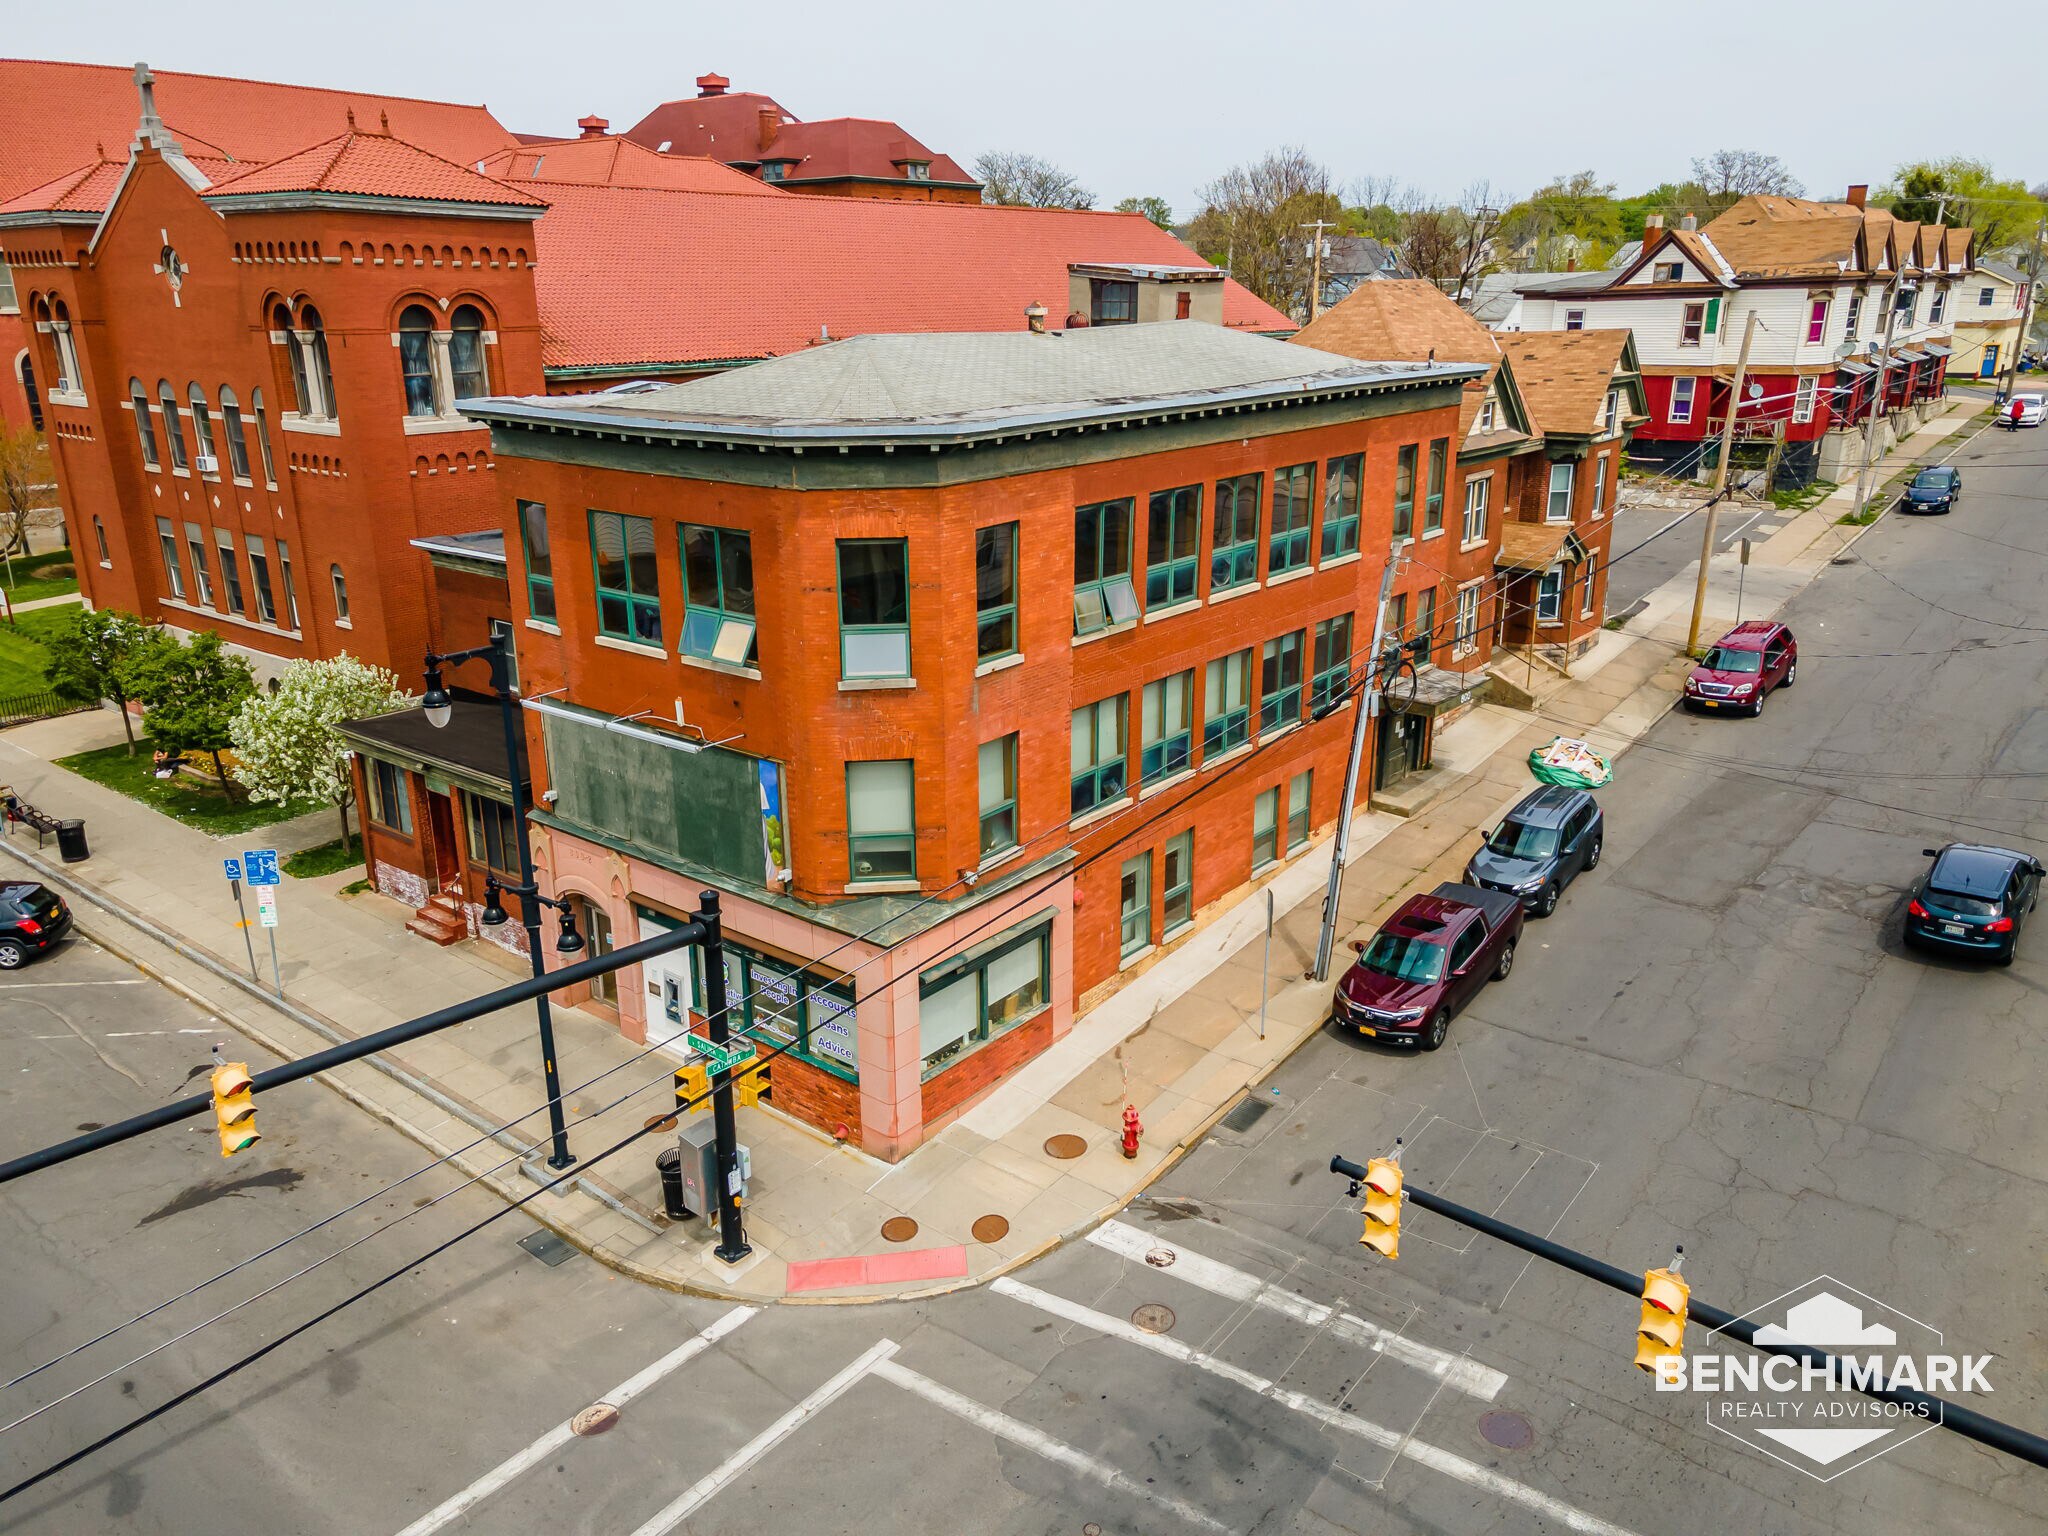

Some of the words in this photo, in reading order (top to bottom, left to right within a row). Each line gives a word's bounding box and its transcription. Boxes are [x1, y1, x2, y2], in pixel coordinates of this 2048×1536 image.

[751, 969, 788, 995] Investing
[760, 985, 789, 1005] People
[809, 993, 857, 1019] Accounts
[818, 1015, 848, 1037] Loans
[818, 1037, 853, 1059] Advice
